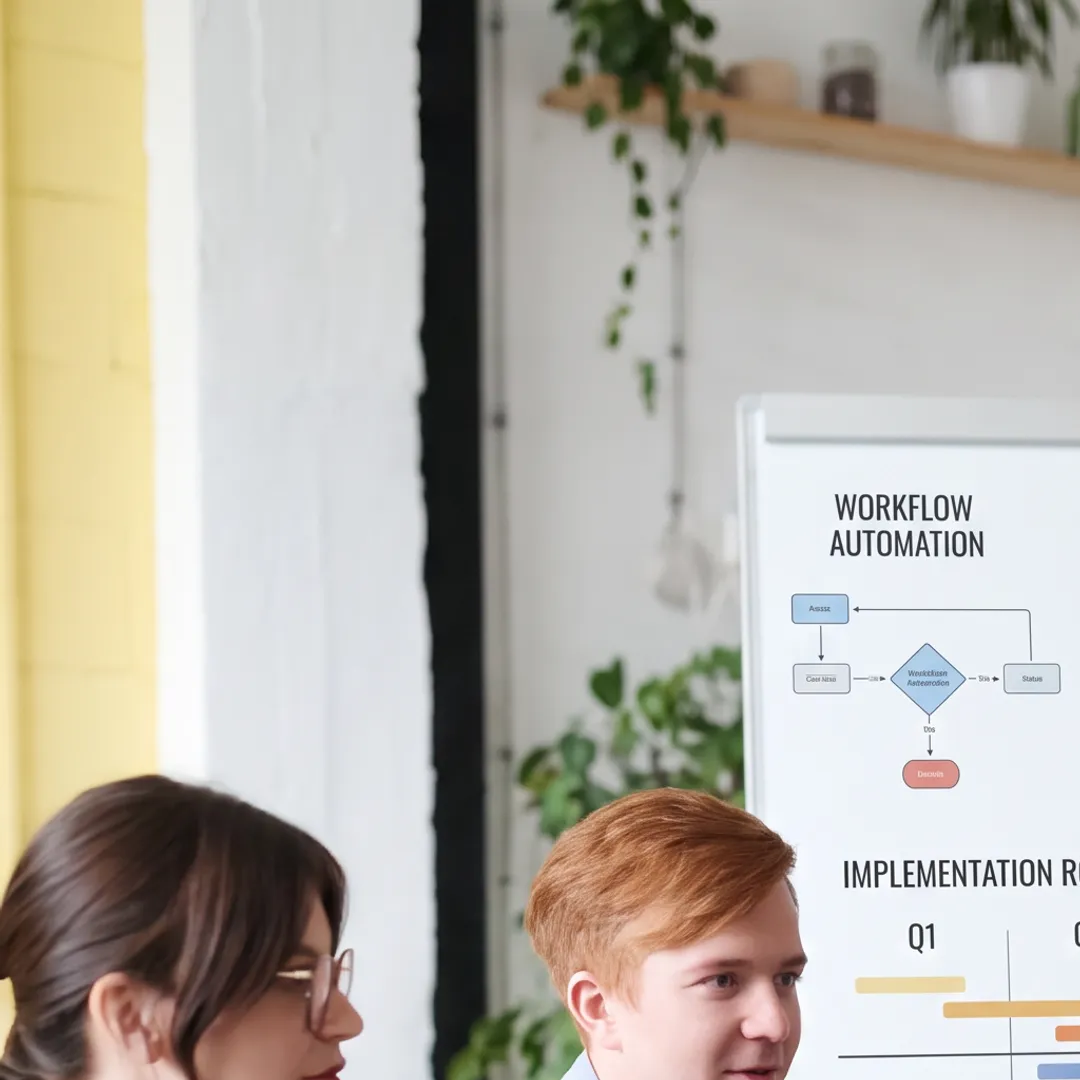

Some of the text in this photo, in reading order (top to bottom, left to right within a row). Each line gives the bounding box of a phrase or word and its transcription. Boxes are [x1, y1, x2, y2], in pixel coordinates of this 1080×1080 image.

[834, 493, 973, 522] WORKFLOW
[829, 529, 985, 558] AUTOMATION
[1021, 674, 1044, 684] Status
[843, 858, 1053, 889] IMPLEMENTATION
[908, 922, 936, 955] Q1
